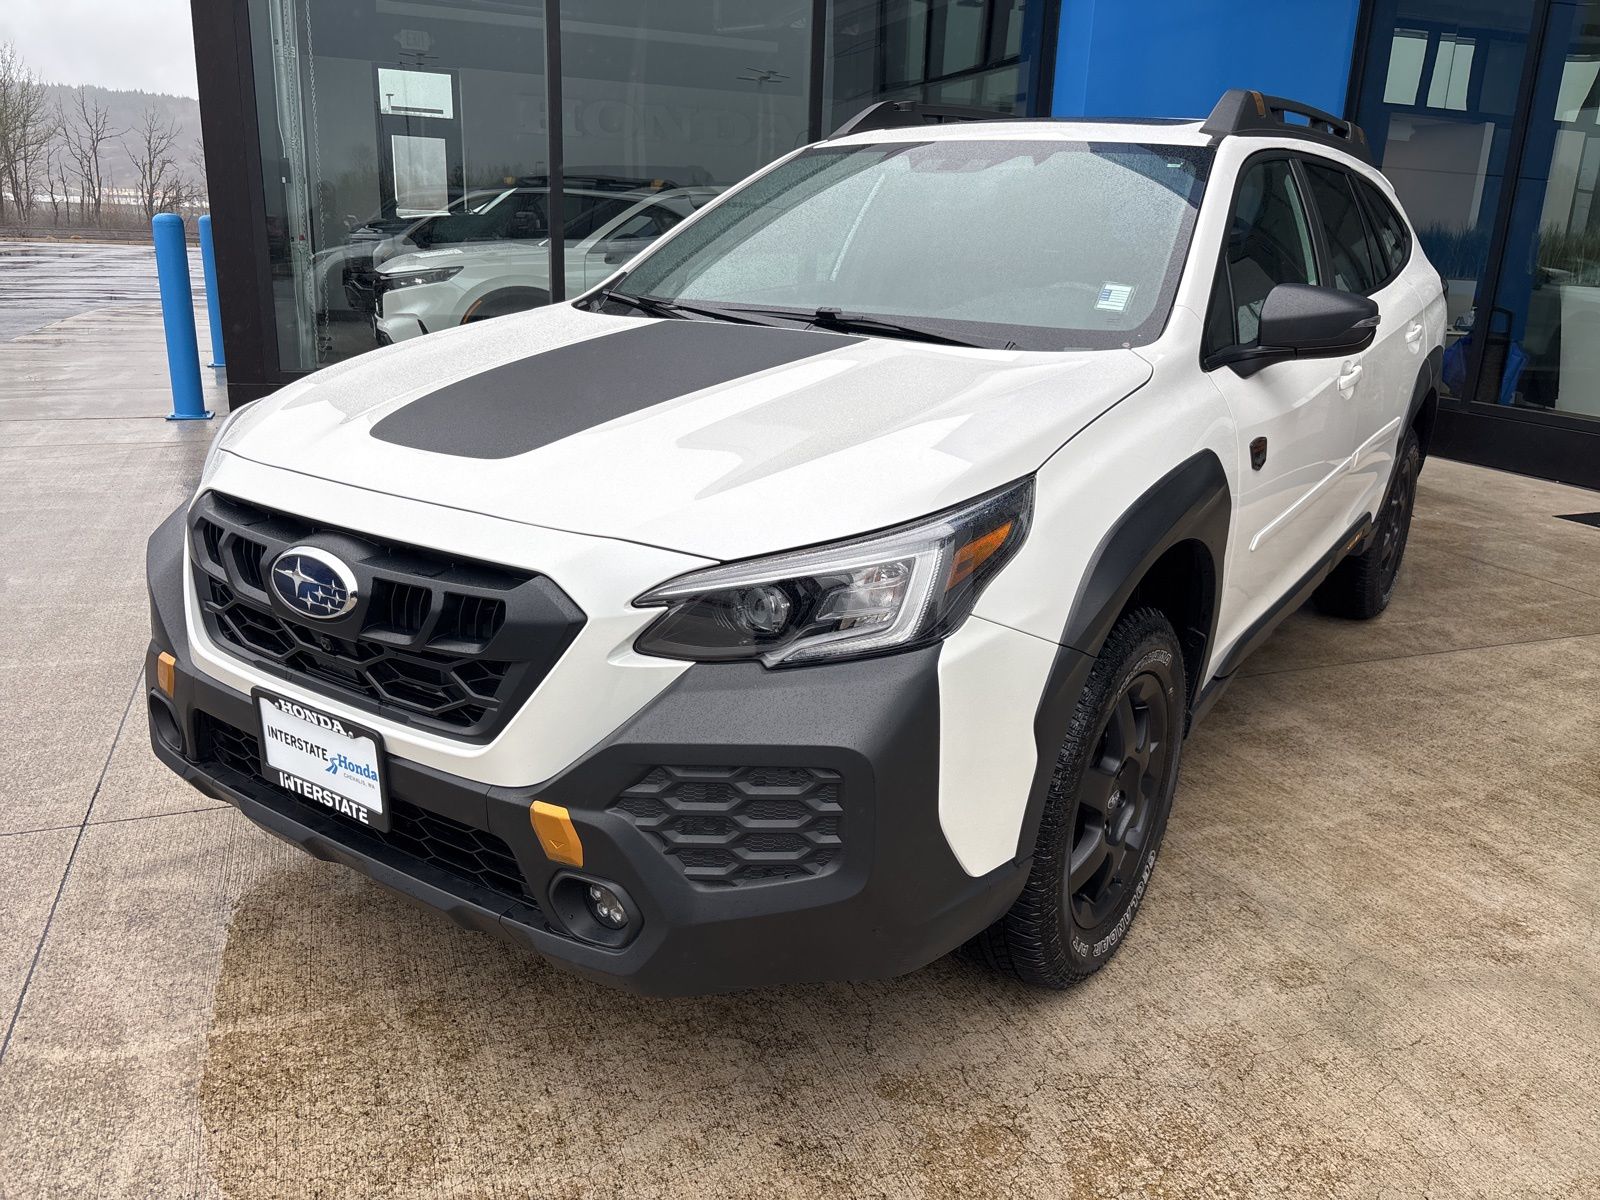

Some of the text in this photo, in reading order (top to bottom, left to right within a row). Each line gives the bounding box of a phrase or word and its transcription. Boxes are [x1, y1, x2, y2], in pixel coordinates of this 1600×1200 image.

[279, 699, 347, 736] HONDA
[267, 725, 378, 781] INTERSTATE Honda
[279, 771, 369, 825] INTERSTATE
